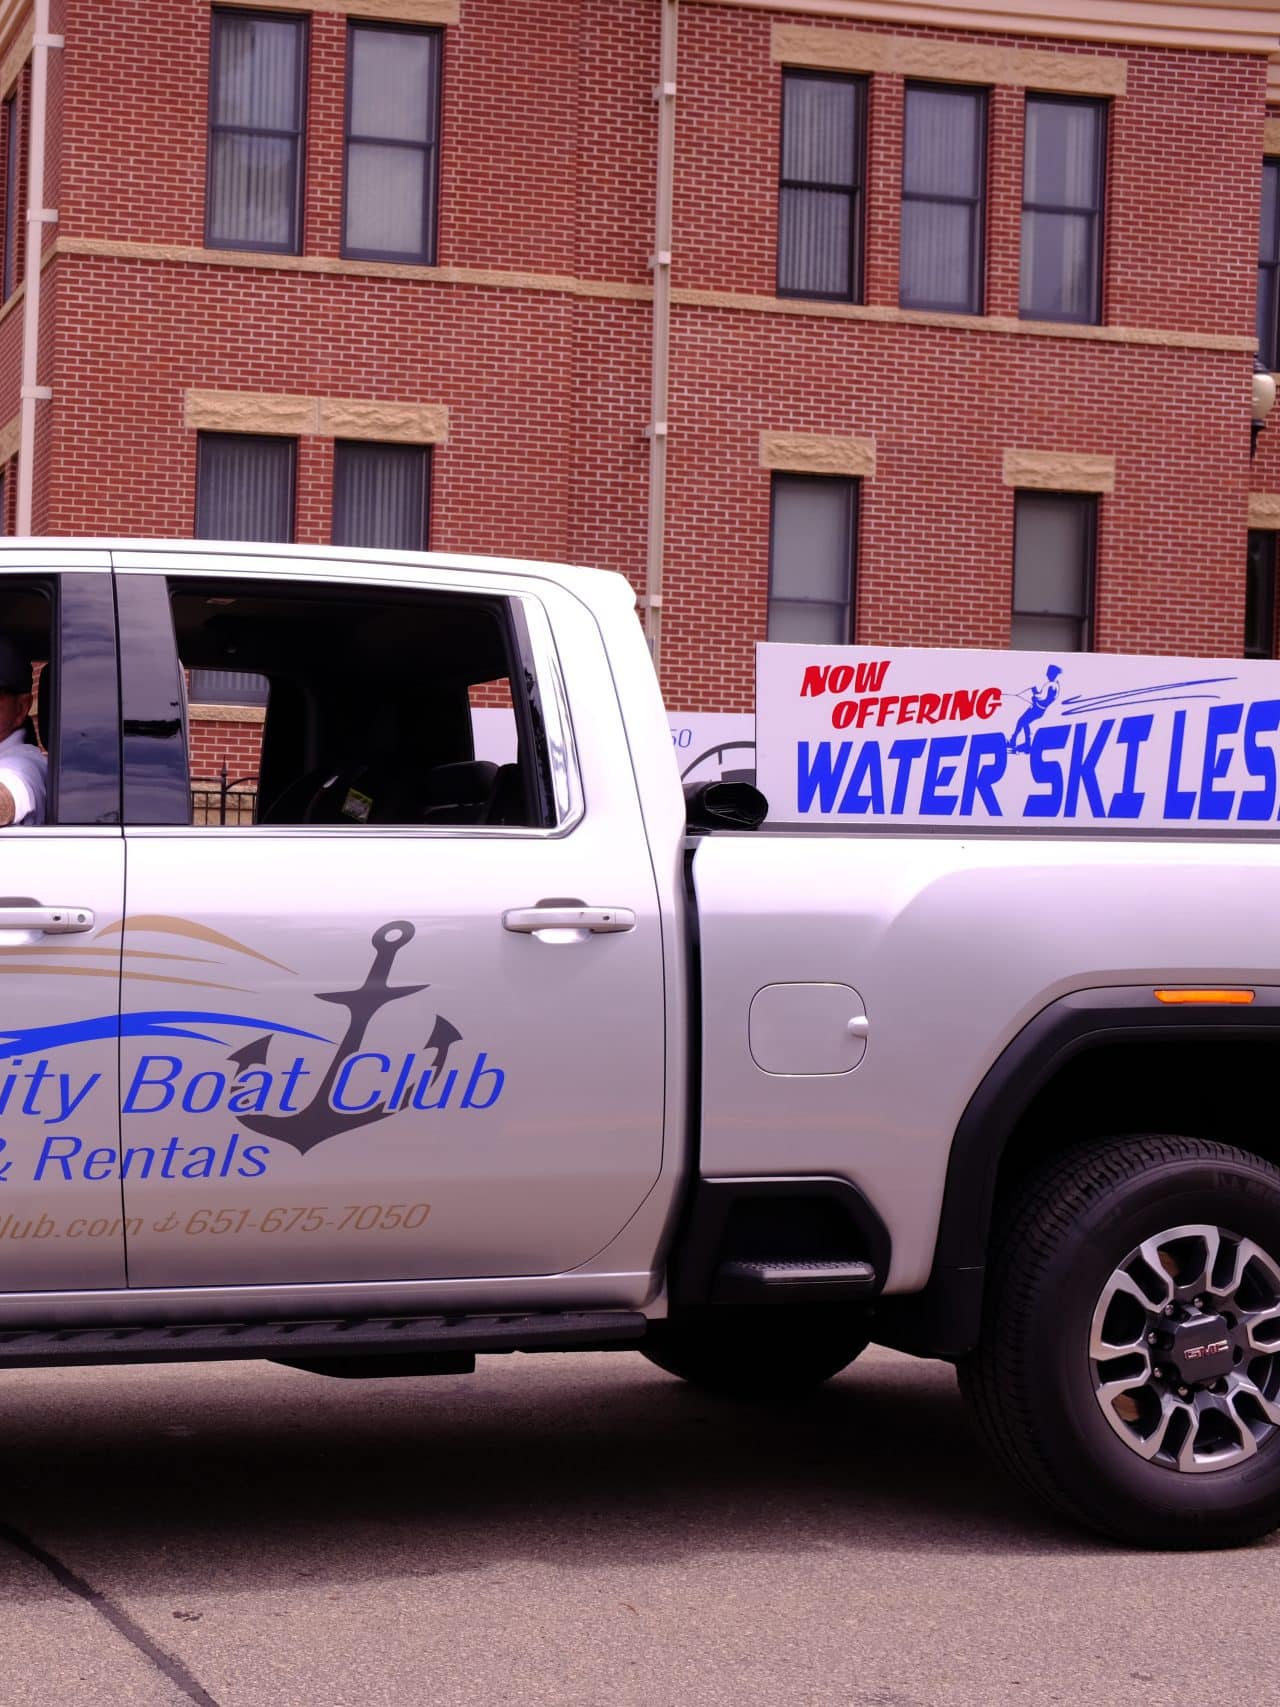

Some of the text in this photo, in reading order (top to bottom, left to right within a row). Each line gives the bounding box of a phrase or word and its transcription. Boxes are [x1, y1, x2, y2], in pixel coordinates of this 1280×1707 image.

[800, 660, 891, 698] NOW
[831, 687, 1003, 730] OFFERING
[796, 699, 1280, 823] WATER SKI LES
[122, 1054, 311, 1116] Boat
[331, 1051, 507, 1114] Club
[34, 1133, 270, 1182] Rentals
[184, 1203, 431, 1236] 651-675-7050
[1183, 1339, 1229, 1360] GMC
